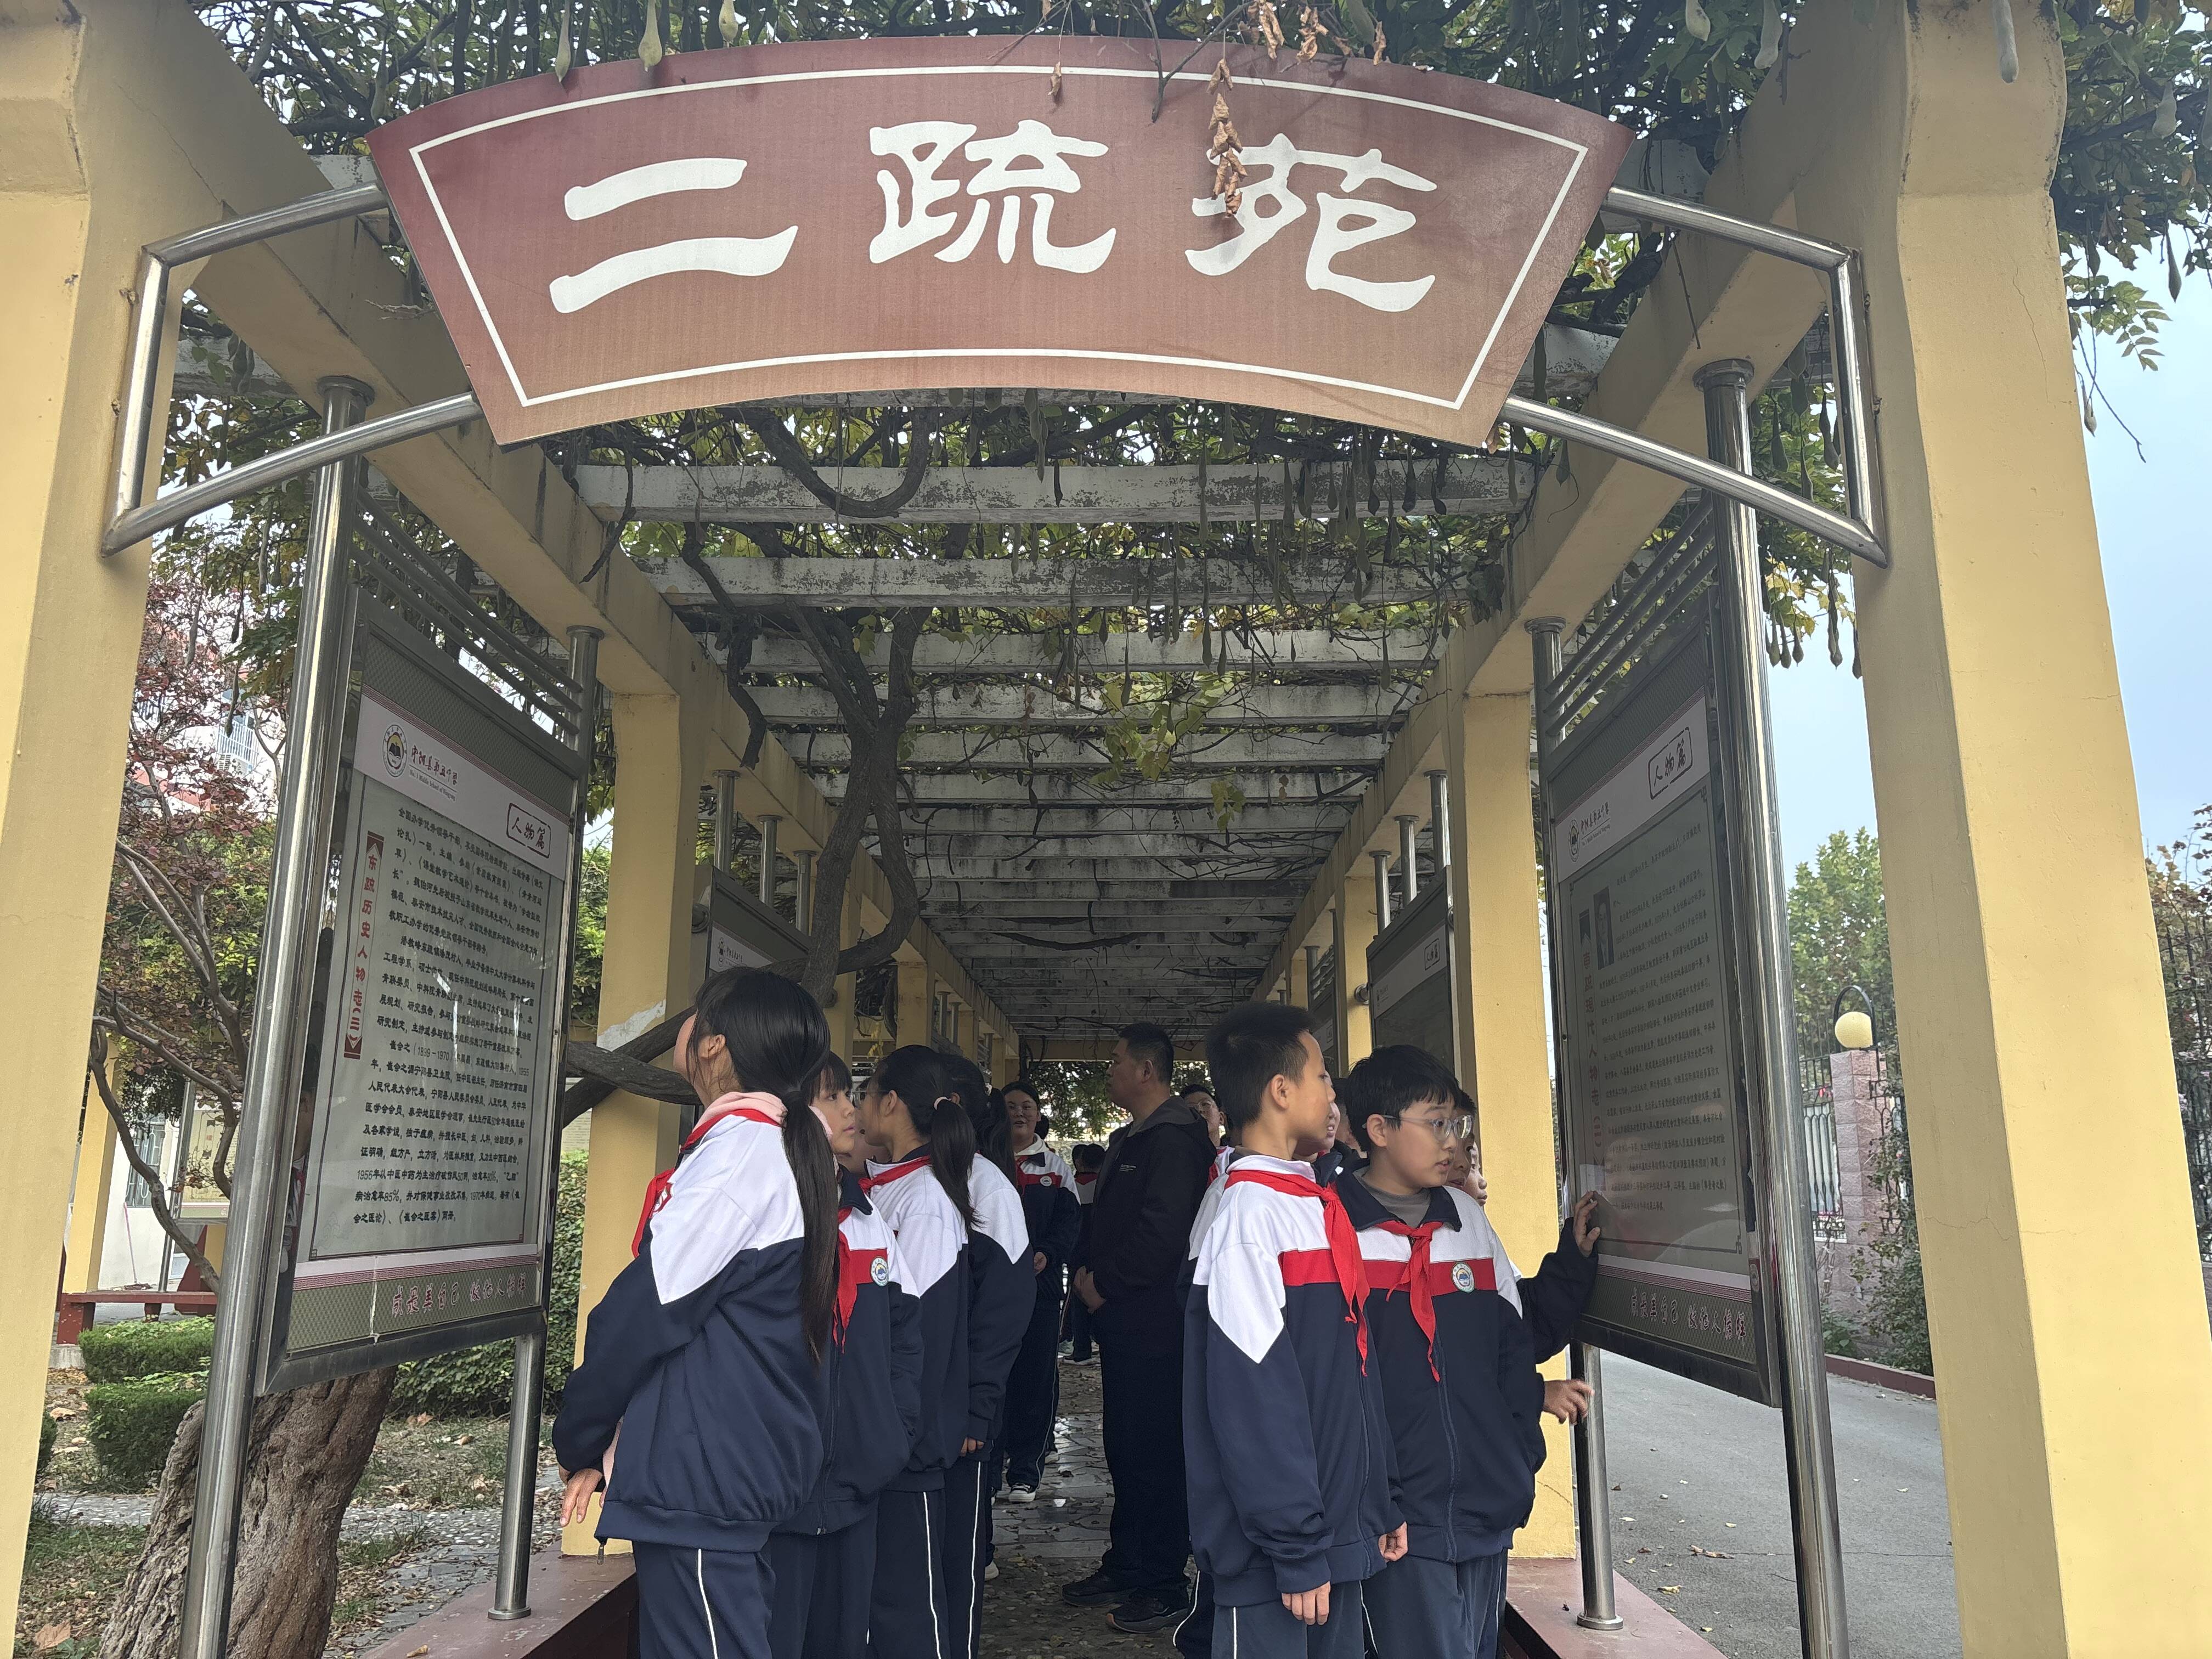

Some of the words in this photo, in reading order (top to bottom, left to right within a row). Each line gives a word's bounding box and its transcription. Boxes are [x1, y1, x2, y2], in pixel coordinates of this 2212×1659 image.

[549, 119, 1437, 313] 二疏苑
[1654, 737, 1686, 787] 人物篇
[511, 817, 545, 850] 人物篇
